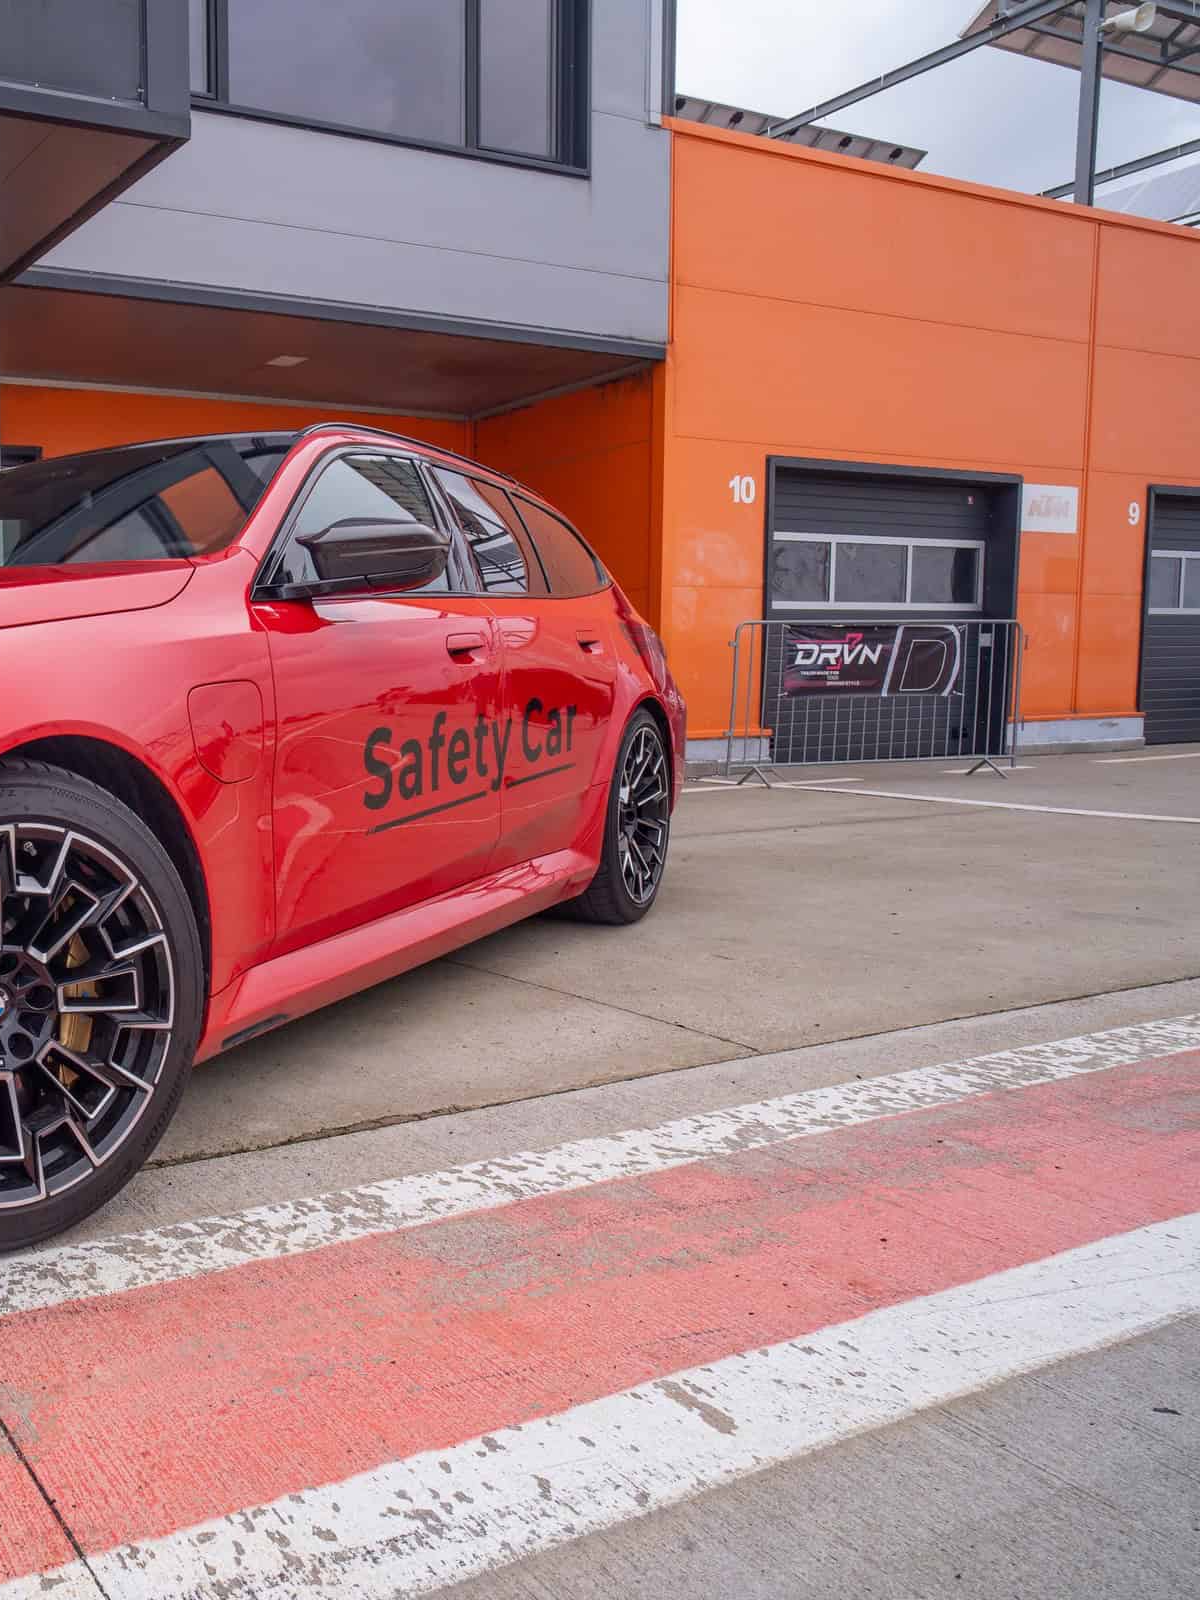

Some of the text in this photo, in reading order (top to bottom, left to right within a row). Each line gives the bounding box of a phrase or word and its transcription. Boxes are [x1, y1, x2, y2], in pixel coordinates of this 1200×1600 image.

[728, 474, 756, 504] 10
[1127, 501, 1141, 526] 9
[794, 643, 883, 665] DRVN
[363, 697, 578, 810] Safety Car
